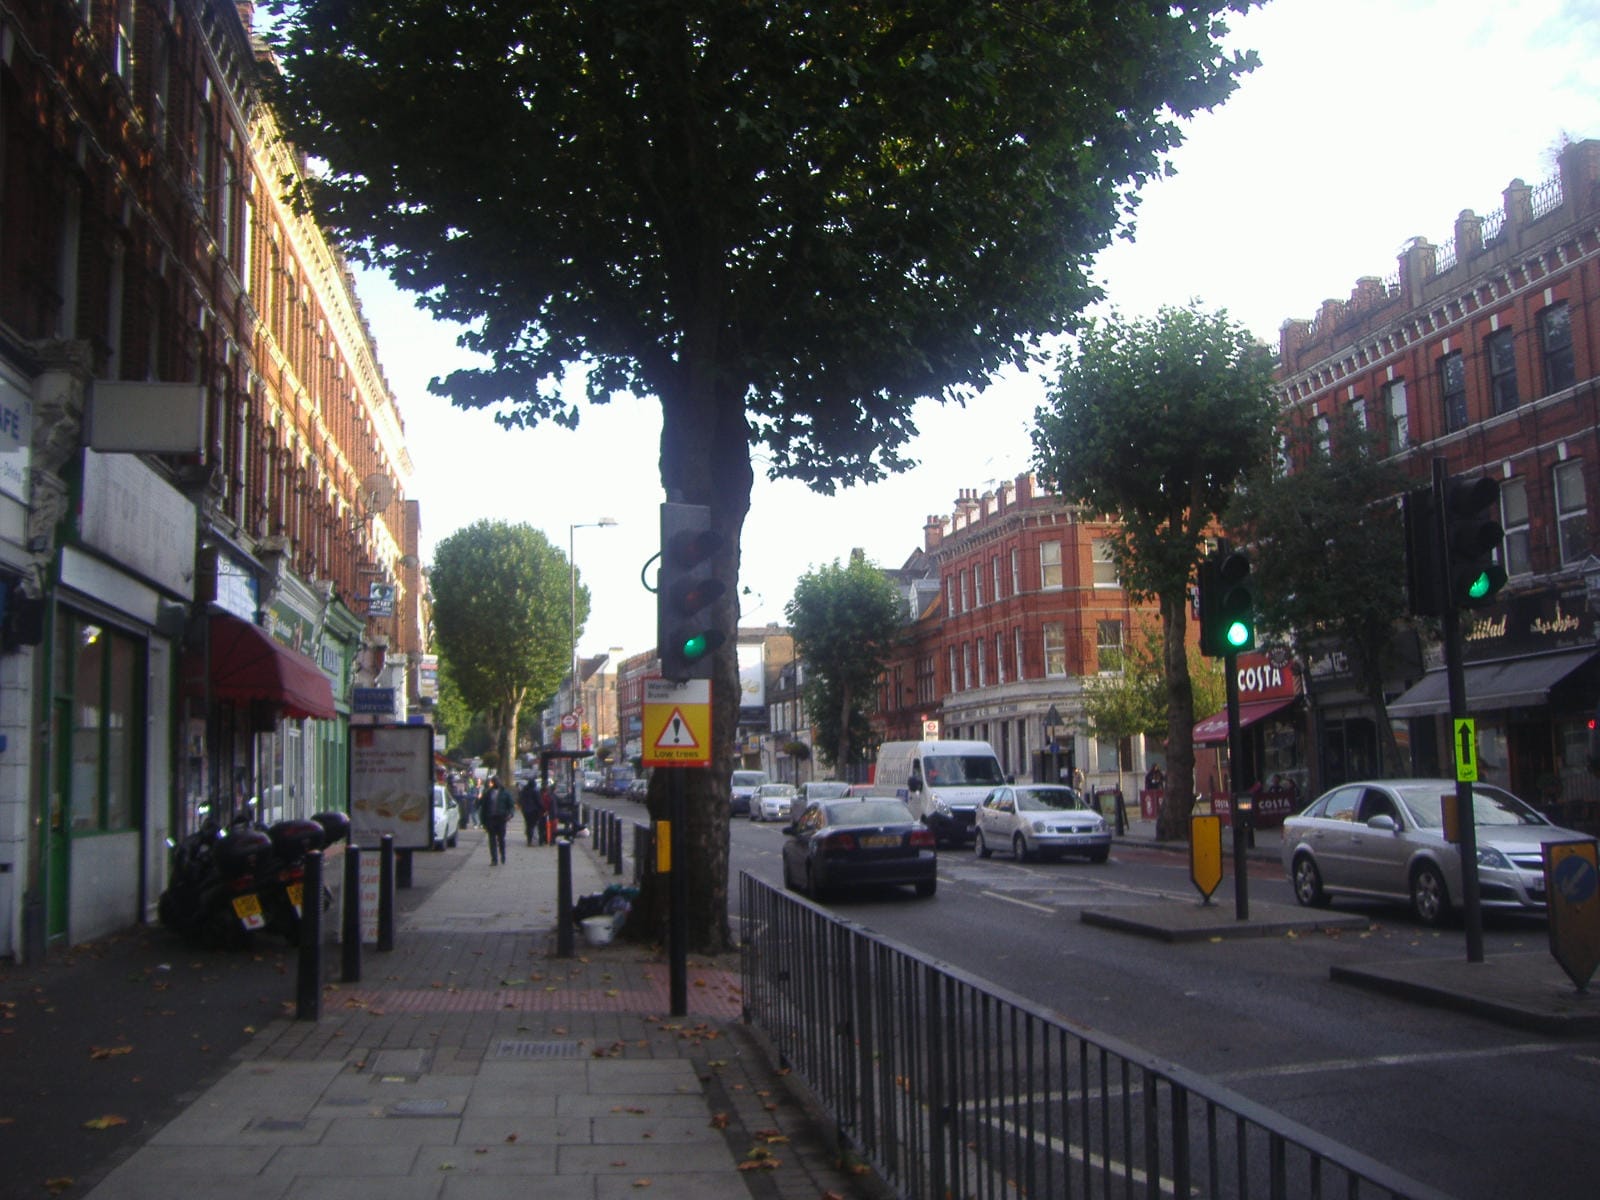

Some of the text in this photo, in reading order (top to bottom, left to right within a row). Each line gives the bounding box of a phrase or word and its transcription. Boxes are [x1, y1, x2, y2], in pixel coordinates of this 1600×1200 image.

[1237, 666, 1282, 692] COSTA
[654, 750, 699, 758] Low trees
[1258, 797, 1291, 810] COSTA
